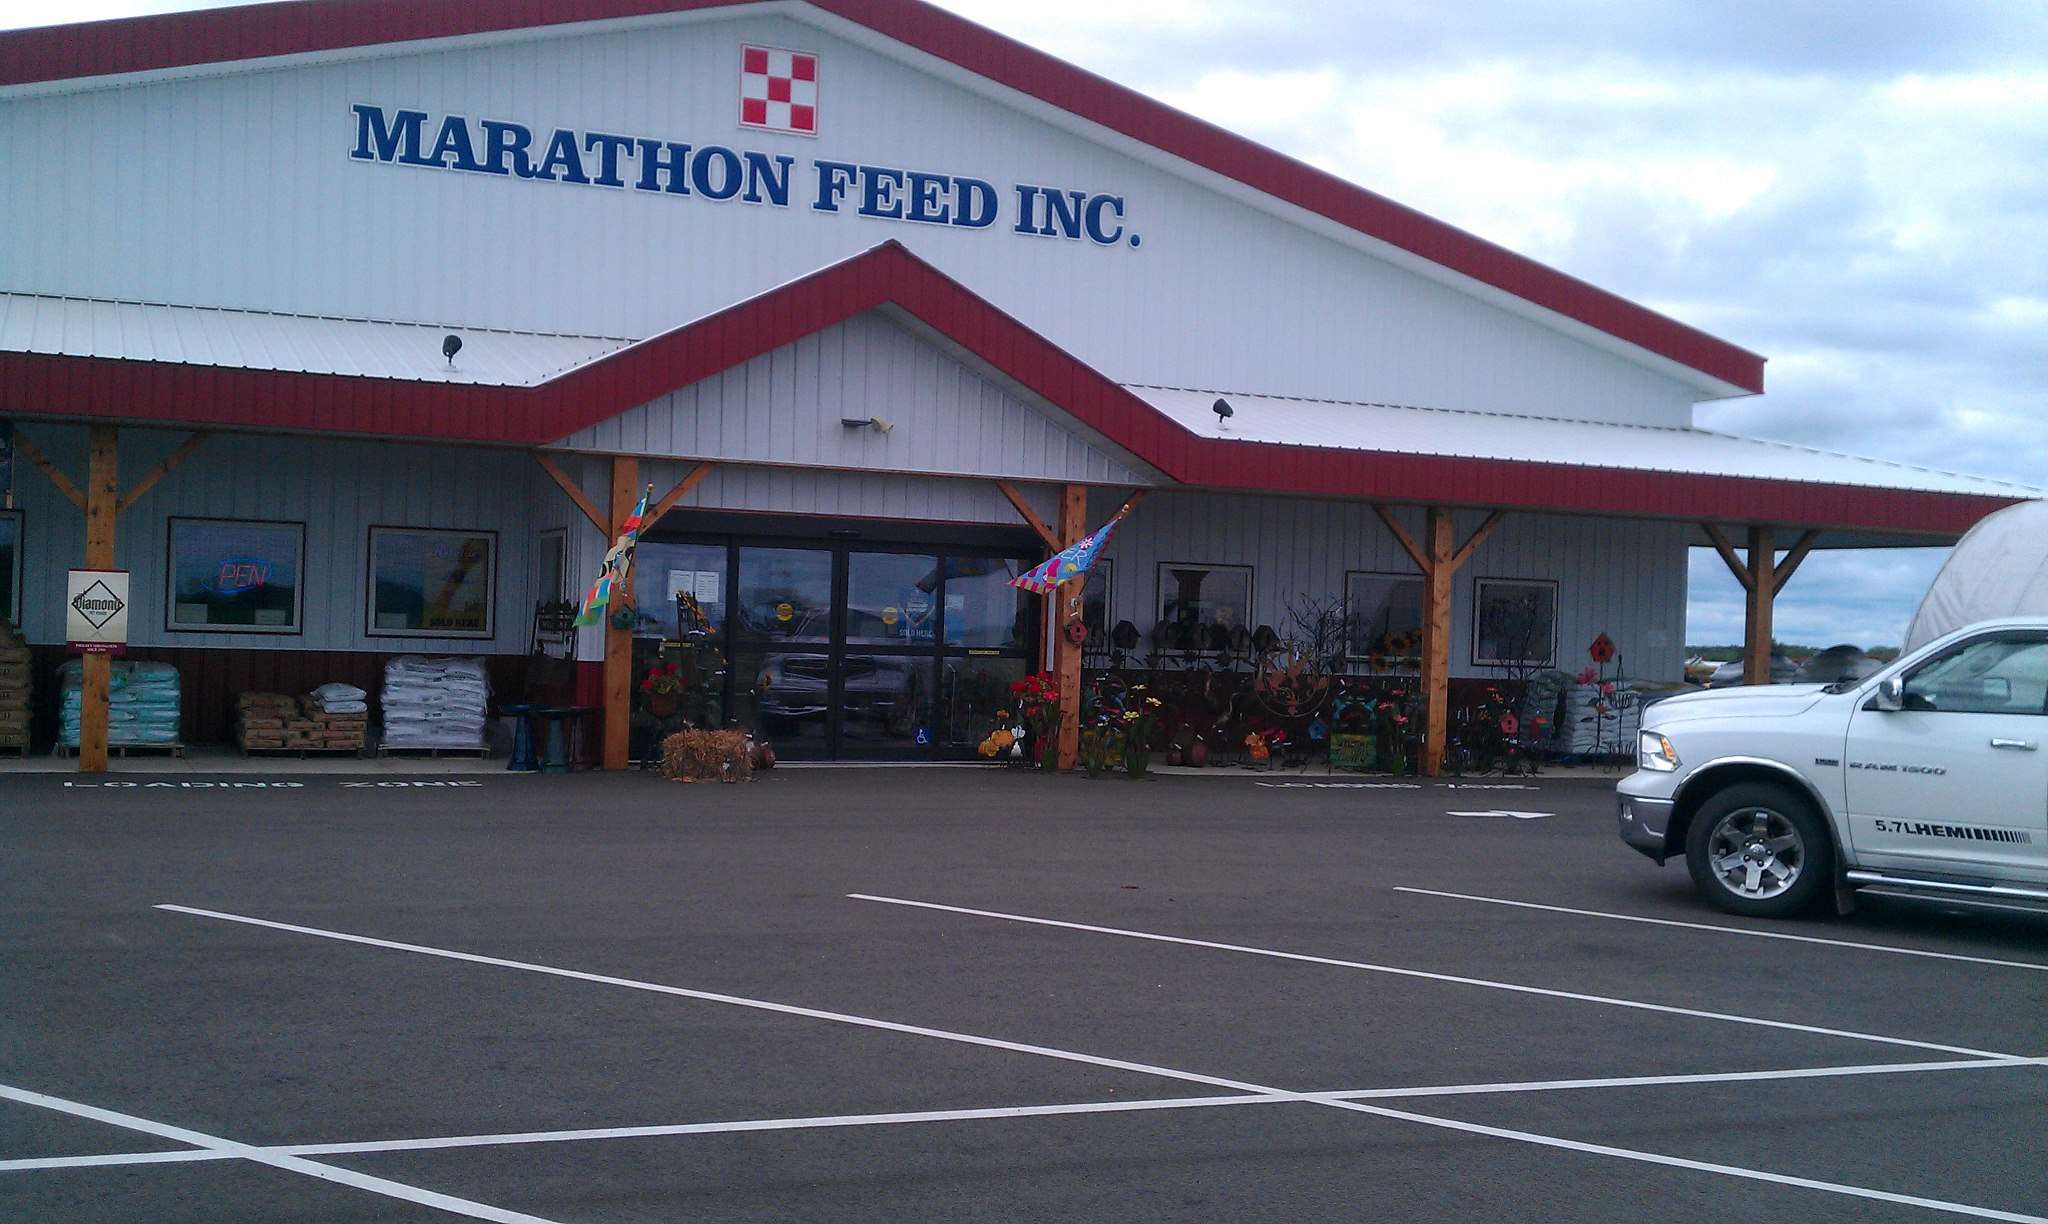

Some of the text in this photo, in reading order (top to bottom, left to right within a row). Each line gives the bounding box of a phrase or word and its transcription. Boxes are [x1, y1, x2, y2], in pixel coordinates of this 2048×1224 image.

[351, 105, 1140, 249] MARATHON FEED INC.
